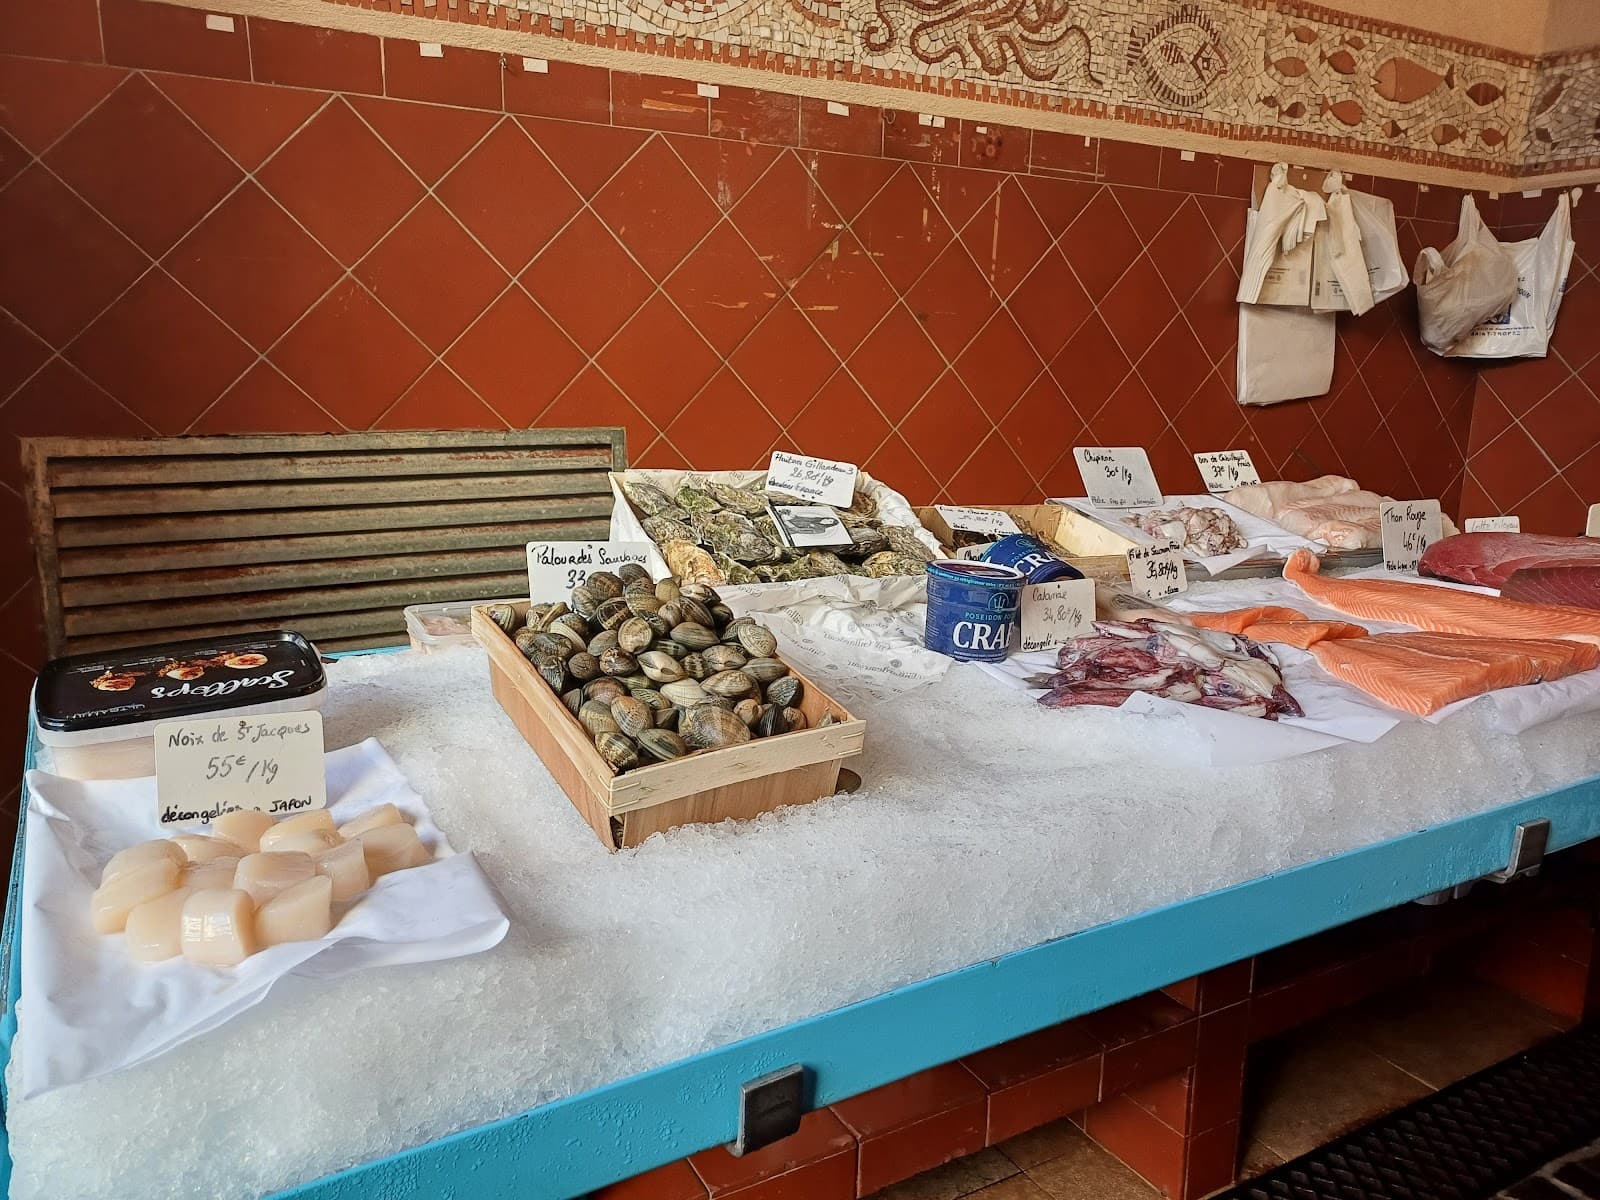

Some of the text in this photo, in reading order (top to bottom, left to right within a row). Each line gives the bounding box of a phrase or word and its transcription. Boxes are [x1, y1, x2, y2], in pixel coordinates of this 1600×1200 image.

[964, 611, 1002, 621] POSEIDON
[150, 669, 296, 699] Scallops
[168, 728, 204, 748] Noix
[211, 724, 229, 743] de
[251, 722, 311, 743] Jacques
[269, 796, 312, 813] JAPON
